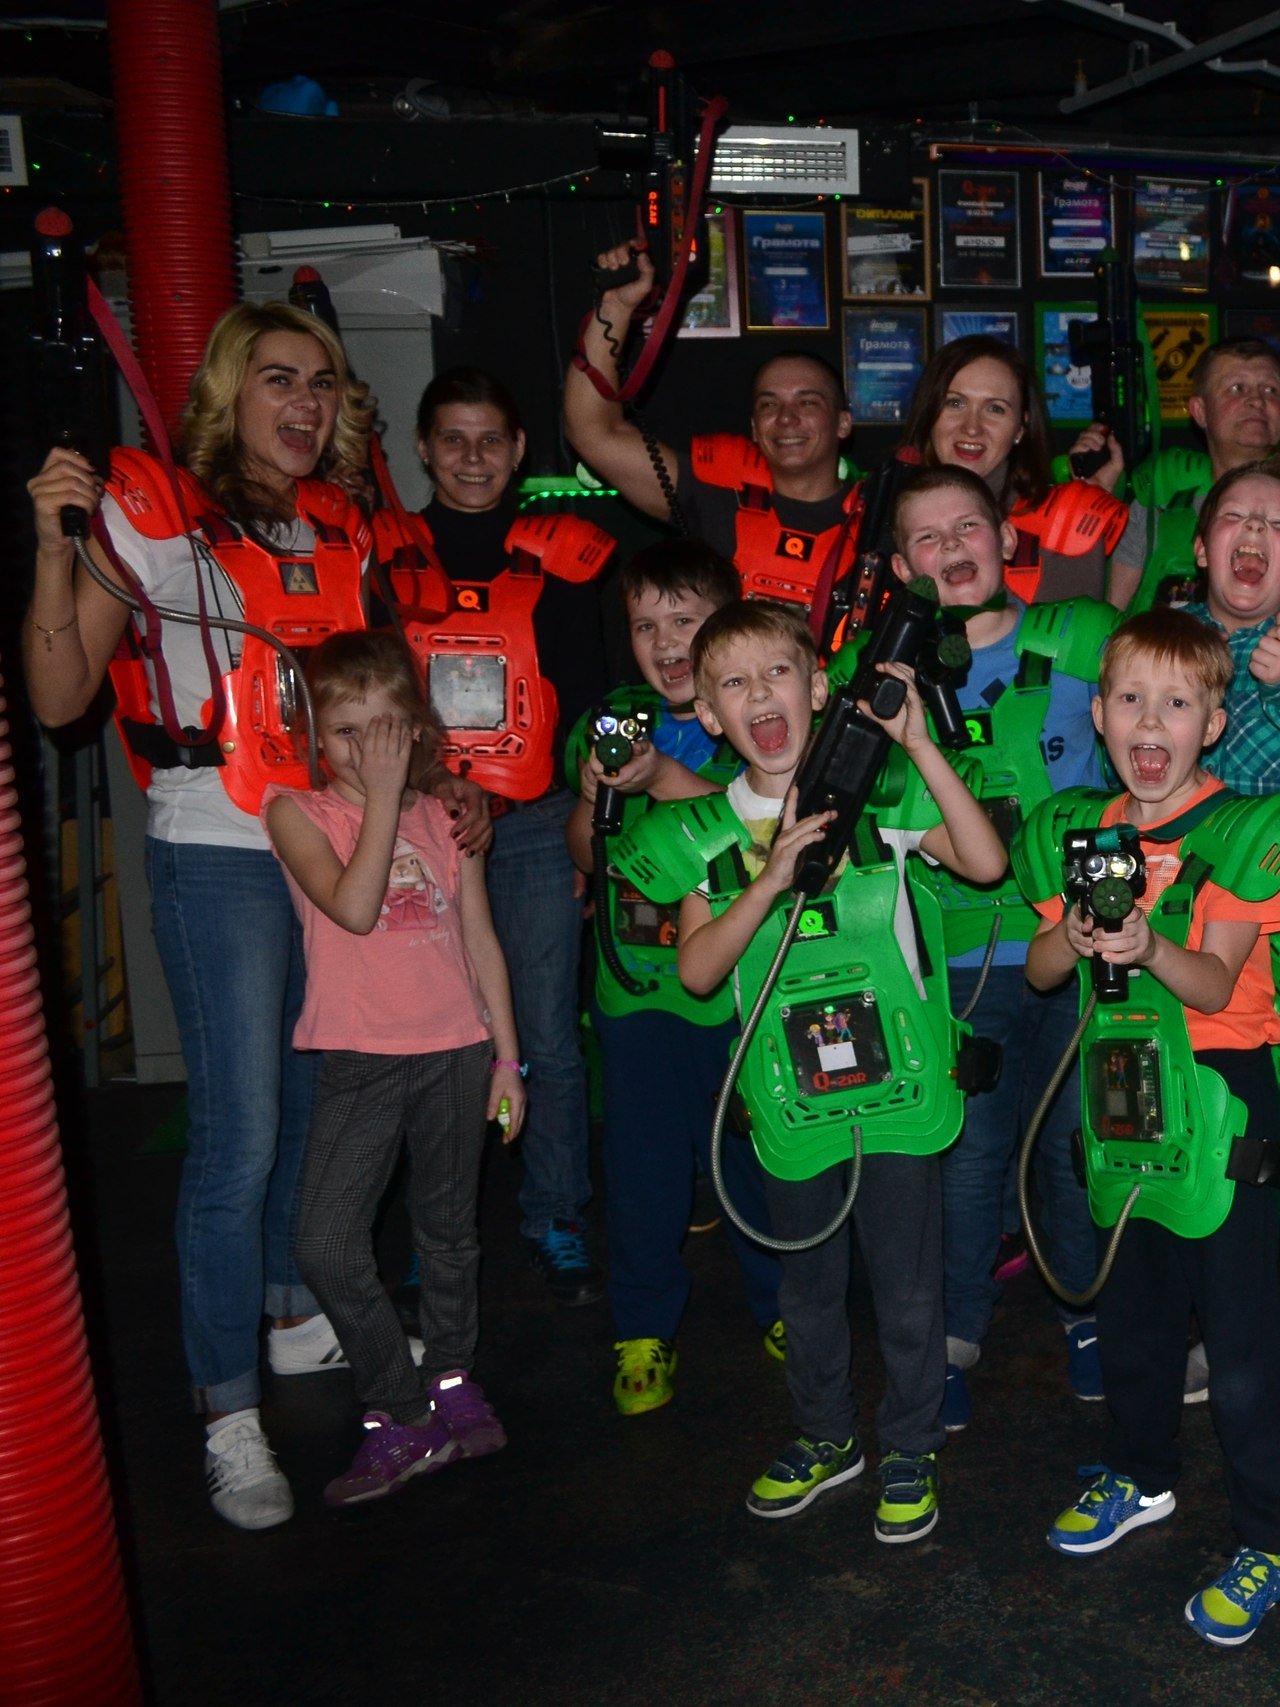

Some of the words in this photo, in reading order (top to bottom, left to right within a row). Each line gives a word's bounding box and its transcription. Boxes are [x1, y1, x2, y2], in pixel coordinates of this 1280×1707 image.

[1054, 197, 1100, 209] Грамота
[856, 208, 916, 221] ДИПЛОМ
[752, 235, 821, 250] Грамота
[859, 338, 911, 352] Грамота
[785, 537, 804, 559] Q
[458, 590, 481, 610] Q
[798, 909, 829, 937] Q
